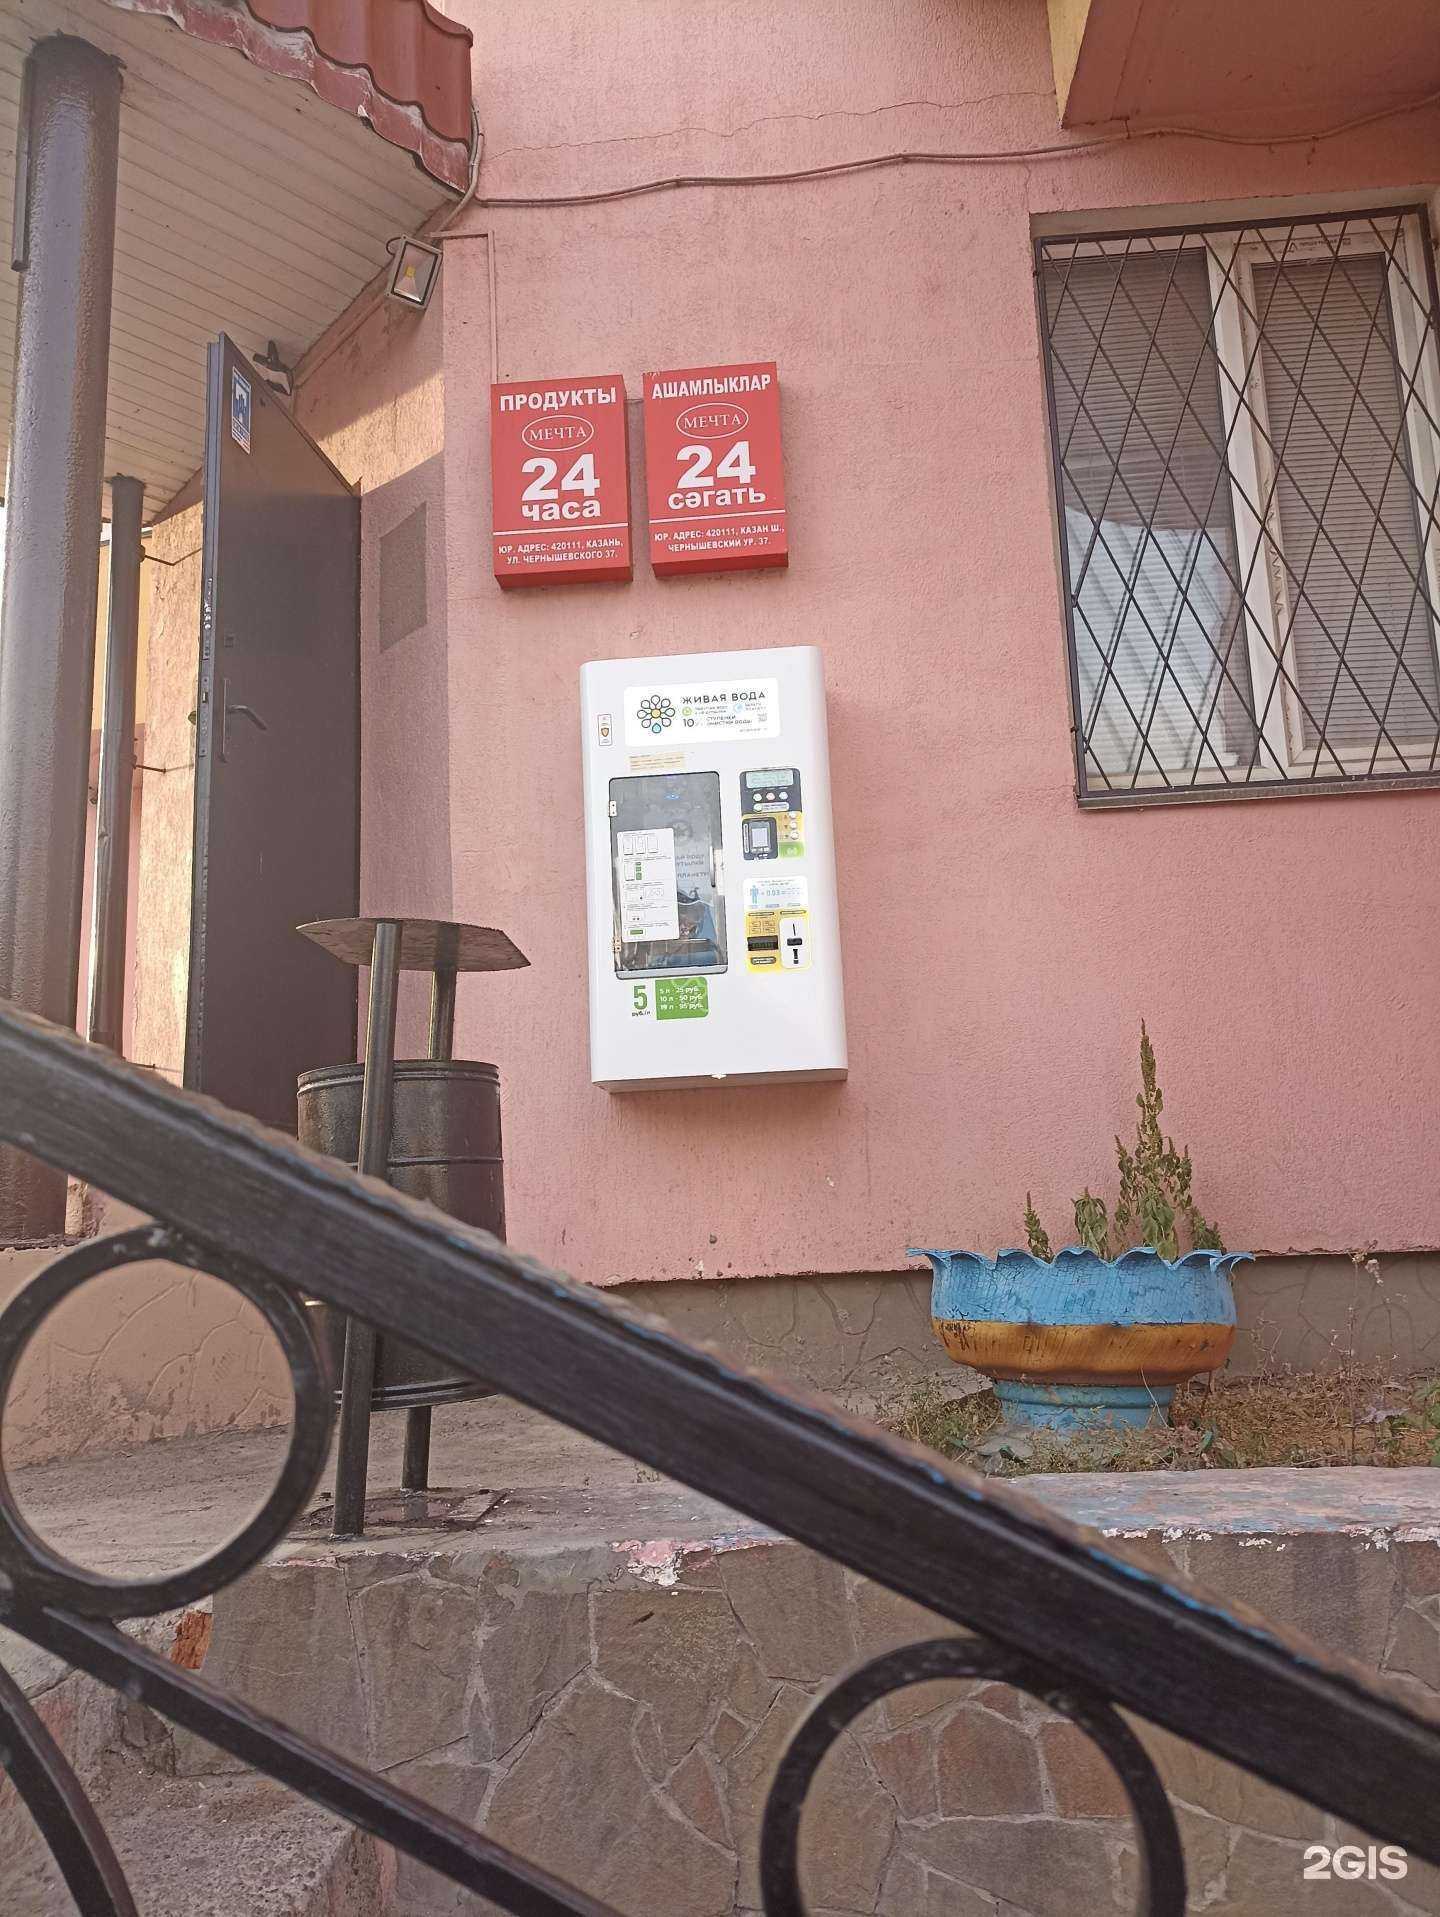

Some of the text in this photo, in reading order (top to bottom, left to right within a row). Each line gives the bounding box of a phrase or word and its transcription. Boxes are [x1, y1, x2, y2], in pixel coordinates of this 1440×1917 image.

[652, 374, 771, 400] АШАМЛЫКЛАР
[500, 387, 616, 412] ПРОДУКТЫ
[684, 413, 741, 429] МЕЧТА
[529, 426, 587, 441] МЕЧТА
[676, 440, 756, 489] 24
[521, 453, 601, 501] 24
[668, 487, 766, 510] сәгать
[521, 499, 601, 521] часа
[654, 532, 671, 541] ЮР.
[673, 530, 704, 540] АДРЕС:
[706, 527, 739, 537] 420111,
[741, 525, 769, 534] КАЗАН
[498, 538, 624, 554] ЮР. АДРЕС: 420111, КАЗАНЬ,
[507, 556, 521, 565] УЛ.
[523, 550, 603, 563] ЧЕРНЫШЕВСКОГО
[682, 691, 766, 704] ЖИВАЯ ВОДА
[633, 985, 648, 1010] 5
